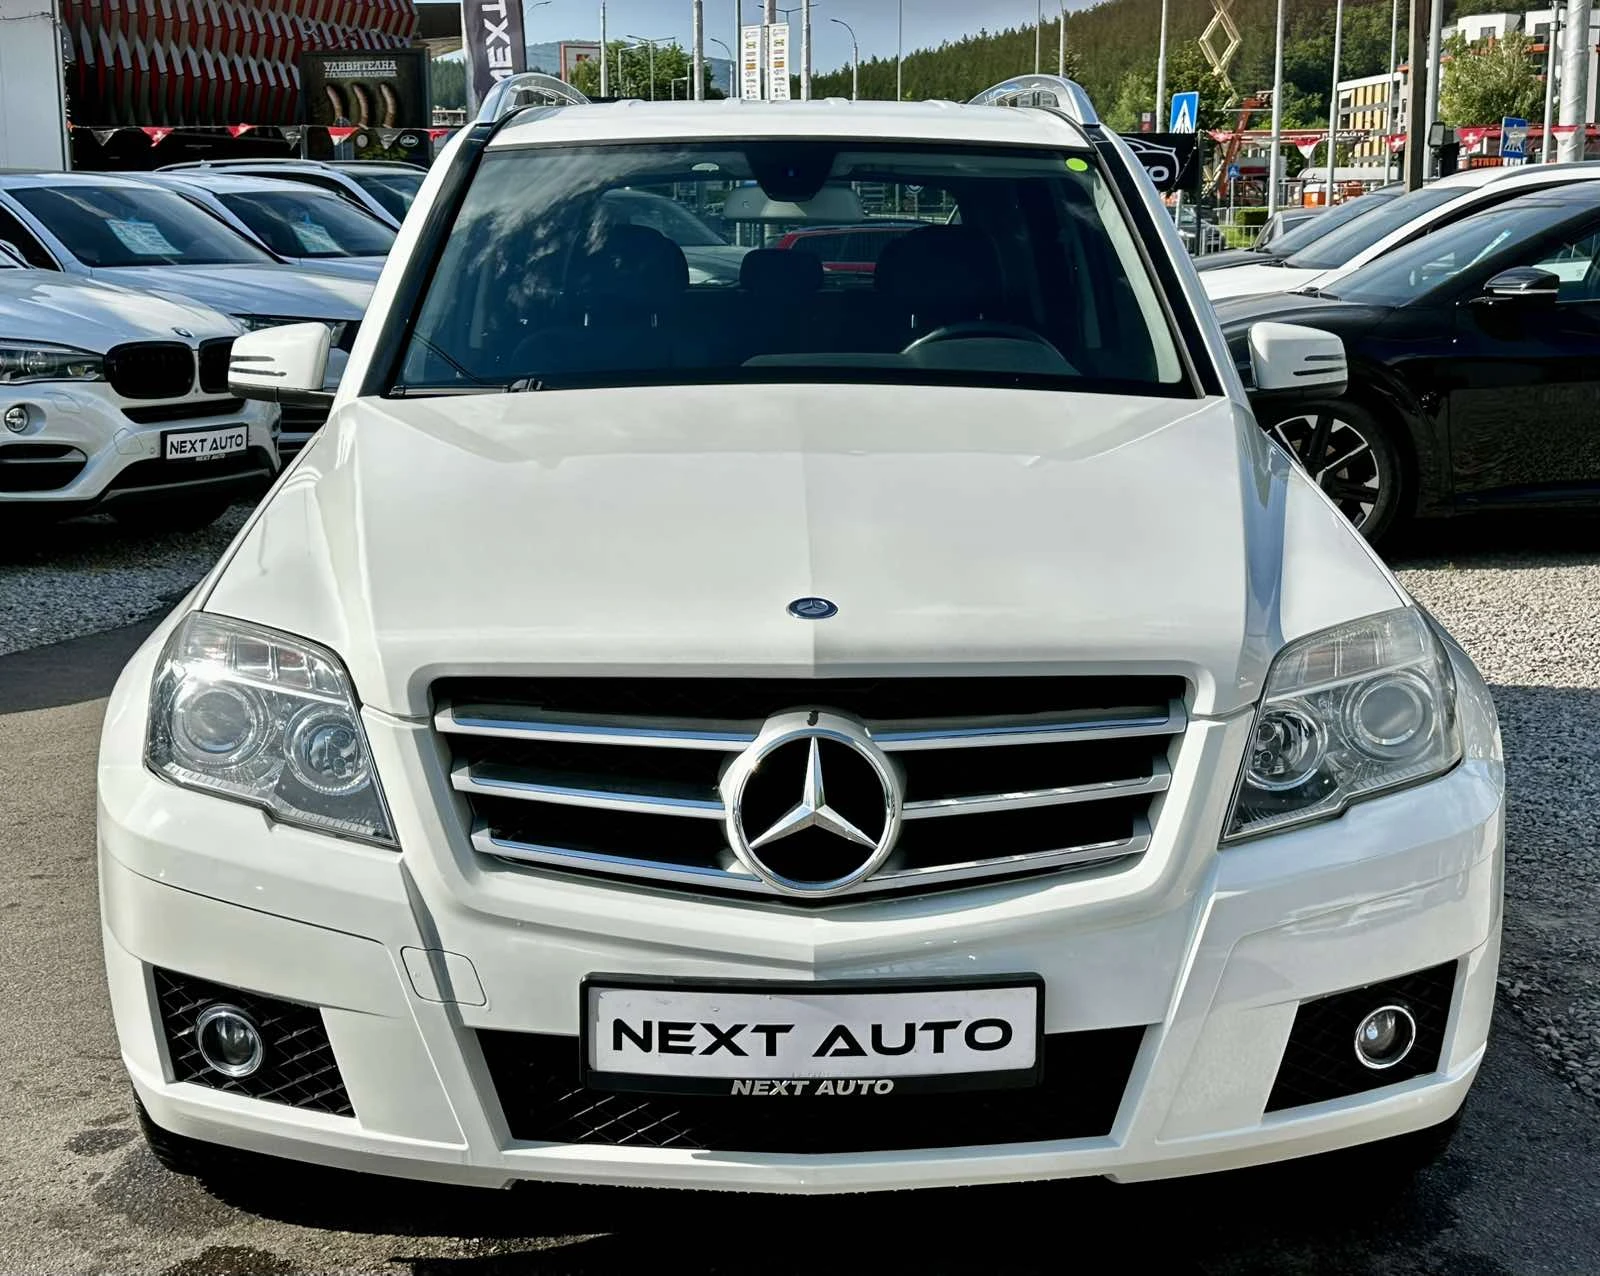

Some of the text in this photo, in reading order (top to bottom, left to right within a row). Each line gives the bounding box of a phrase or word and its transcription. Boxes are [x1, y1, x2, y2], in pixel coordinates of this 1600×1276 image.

[169, 434, 244, 455] NEXT AUTO
[612, 1017, 1013, 1057] NEXT AUTO
[730, 1078, 895, 1096] NEXT AUTO
